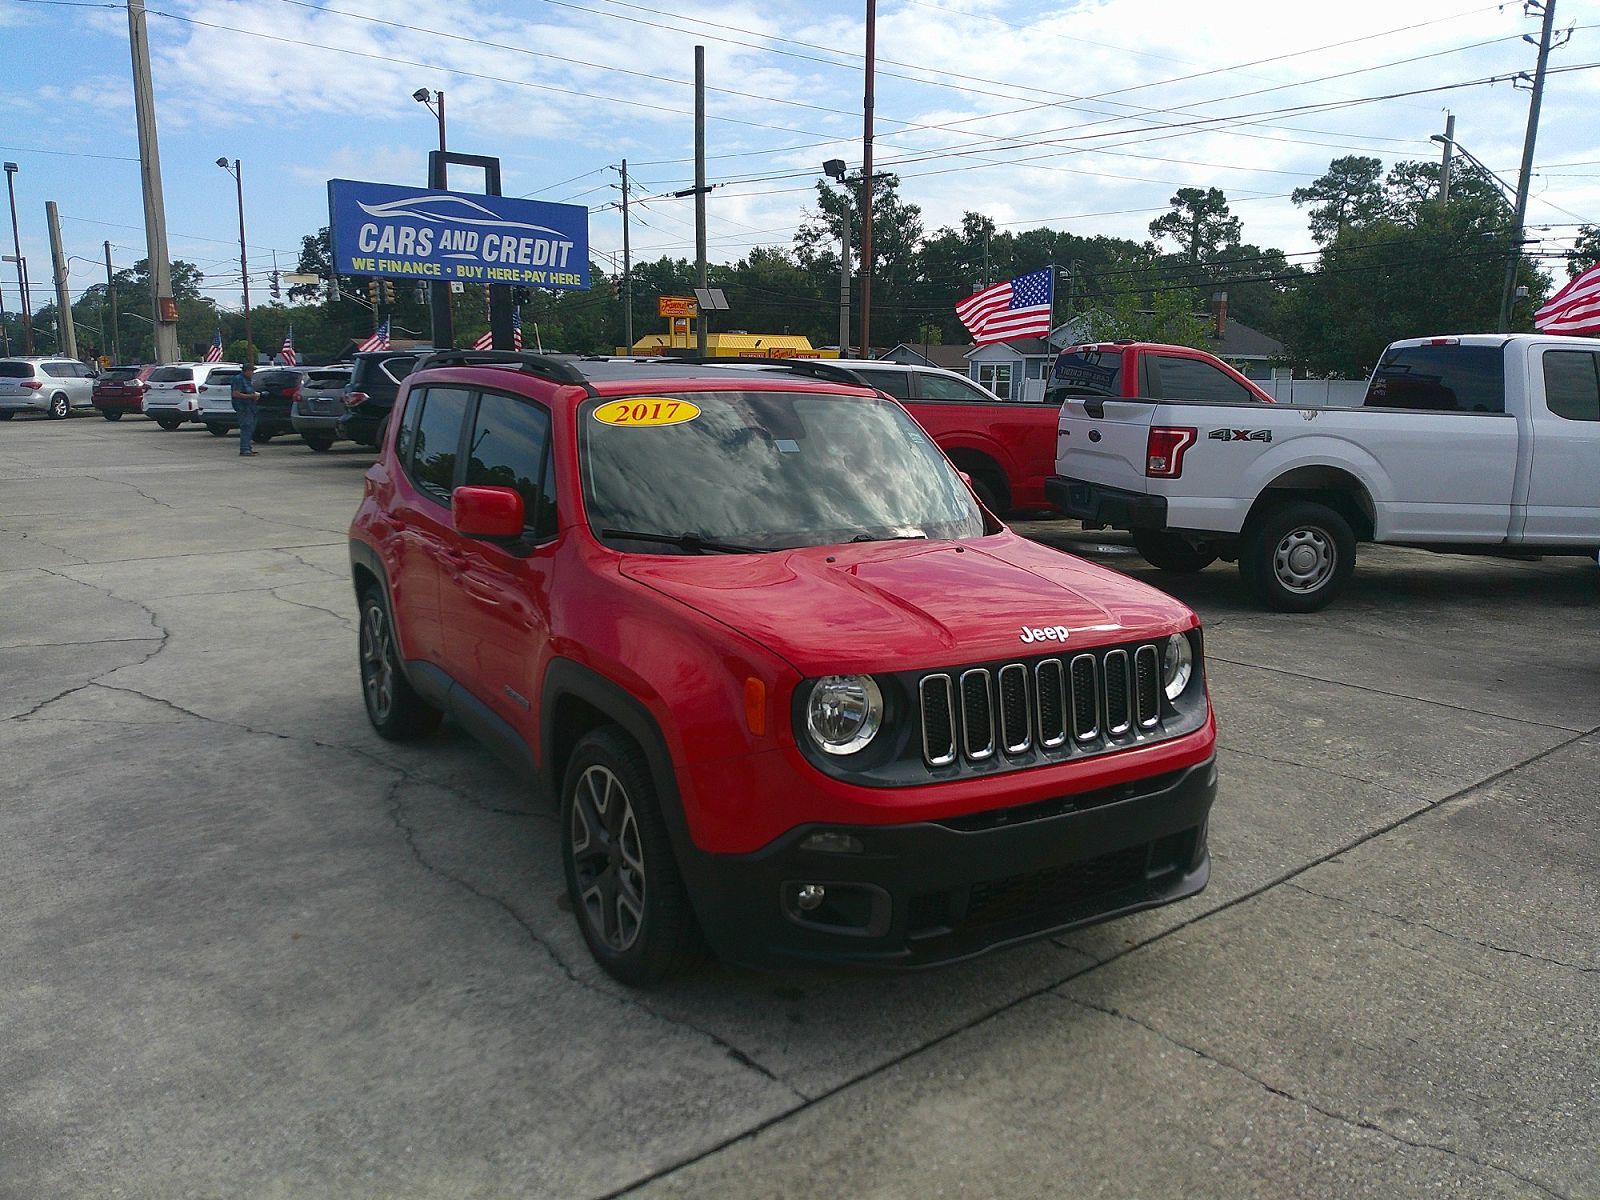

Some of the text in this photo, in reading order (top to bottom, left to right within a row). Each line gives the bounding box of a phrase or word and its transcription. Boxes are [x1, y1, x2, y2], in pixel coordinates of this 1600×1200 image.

[358, 223, 574, 268] CARS AND CREDIT
[352, 257, 375, 271] WE
[378, 259, 441, 276] FINANCE
[456, 266, 484, 279] BUY
[549, 273, 581, 286] HERE
[614, 403, 681, 423] 2017
[1019, 625, 1070, 644] Jeep
